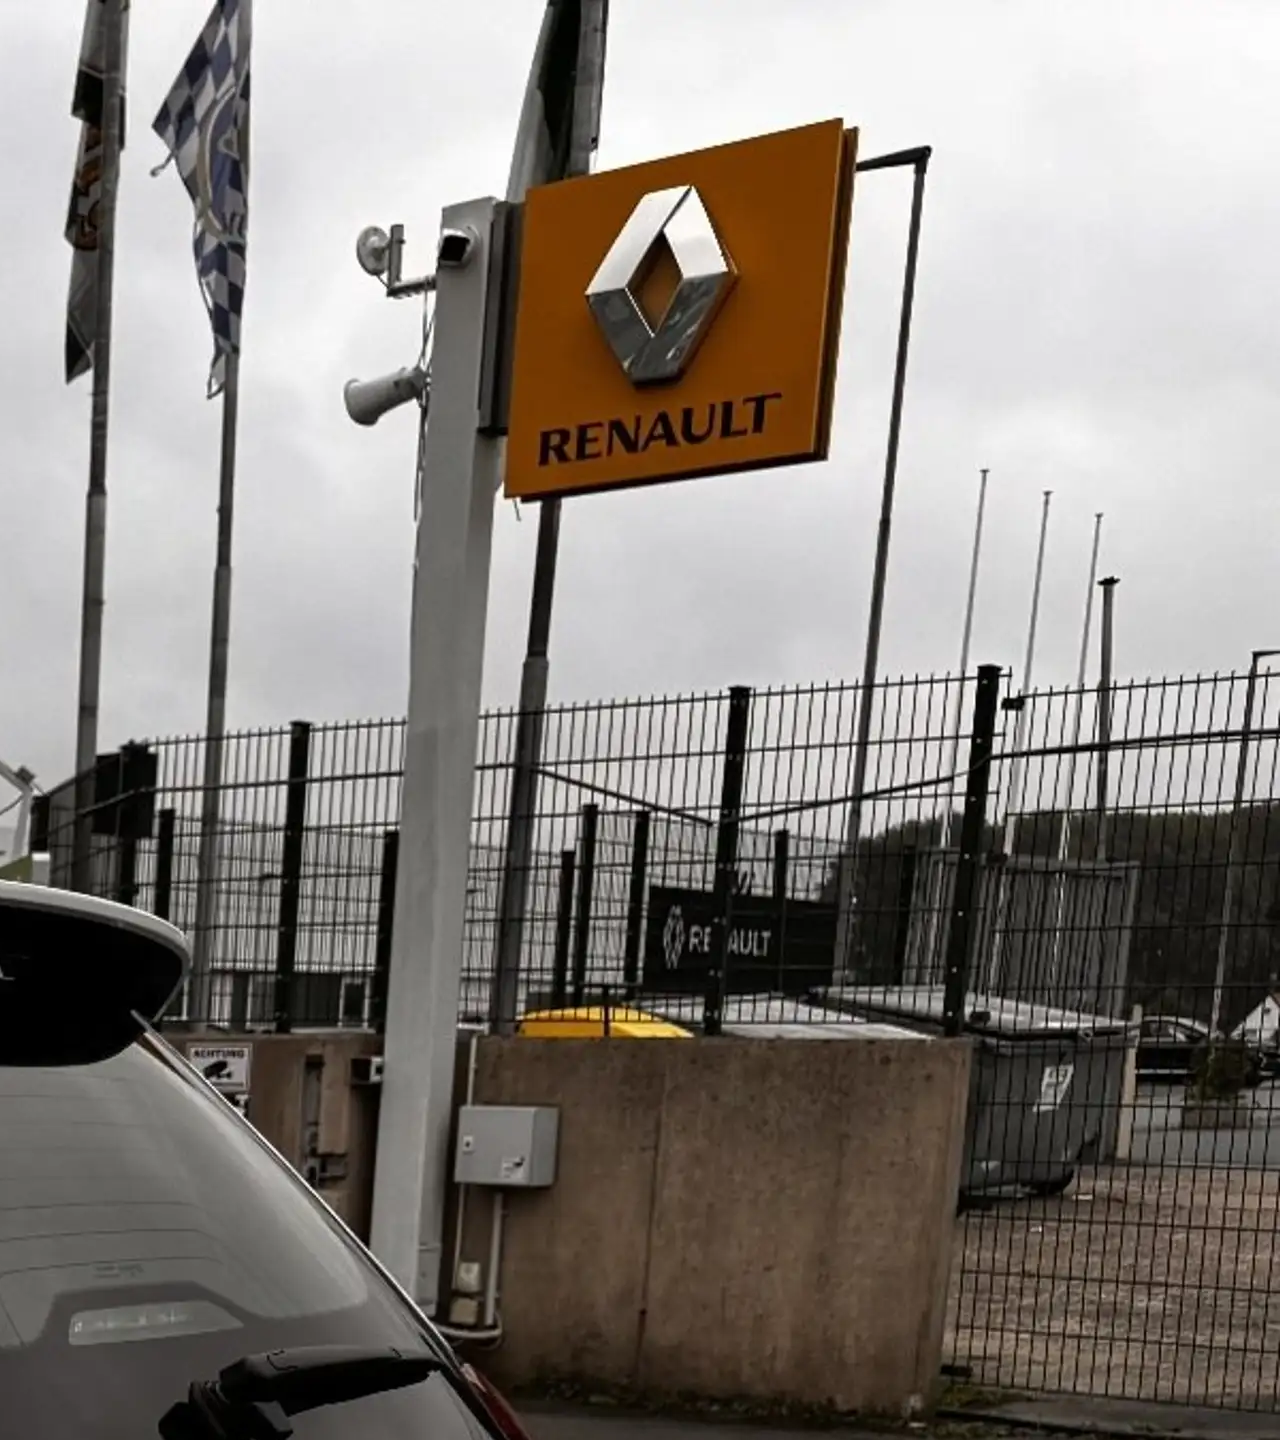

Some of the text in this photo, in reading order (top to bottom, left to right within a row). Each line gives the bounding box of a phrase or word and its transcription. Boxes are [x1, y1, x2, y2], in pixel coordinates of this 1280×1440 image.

[538, 391, 782, 467] RENAULT
[689, 924, 772, 957] REAULT
[193, 1048, 245, 1059] ACHTUNG
